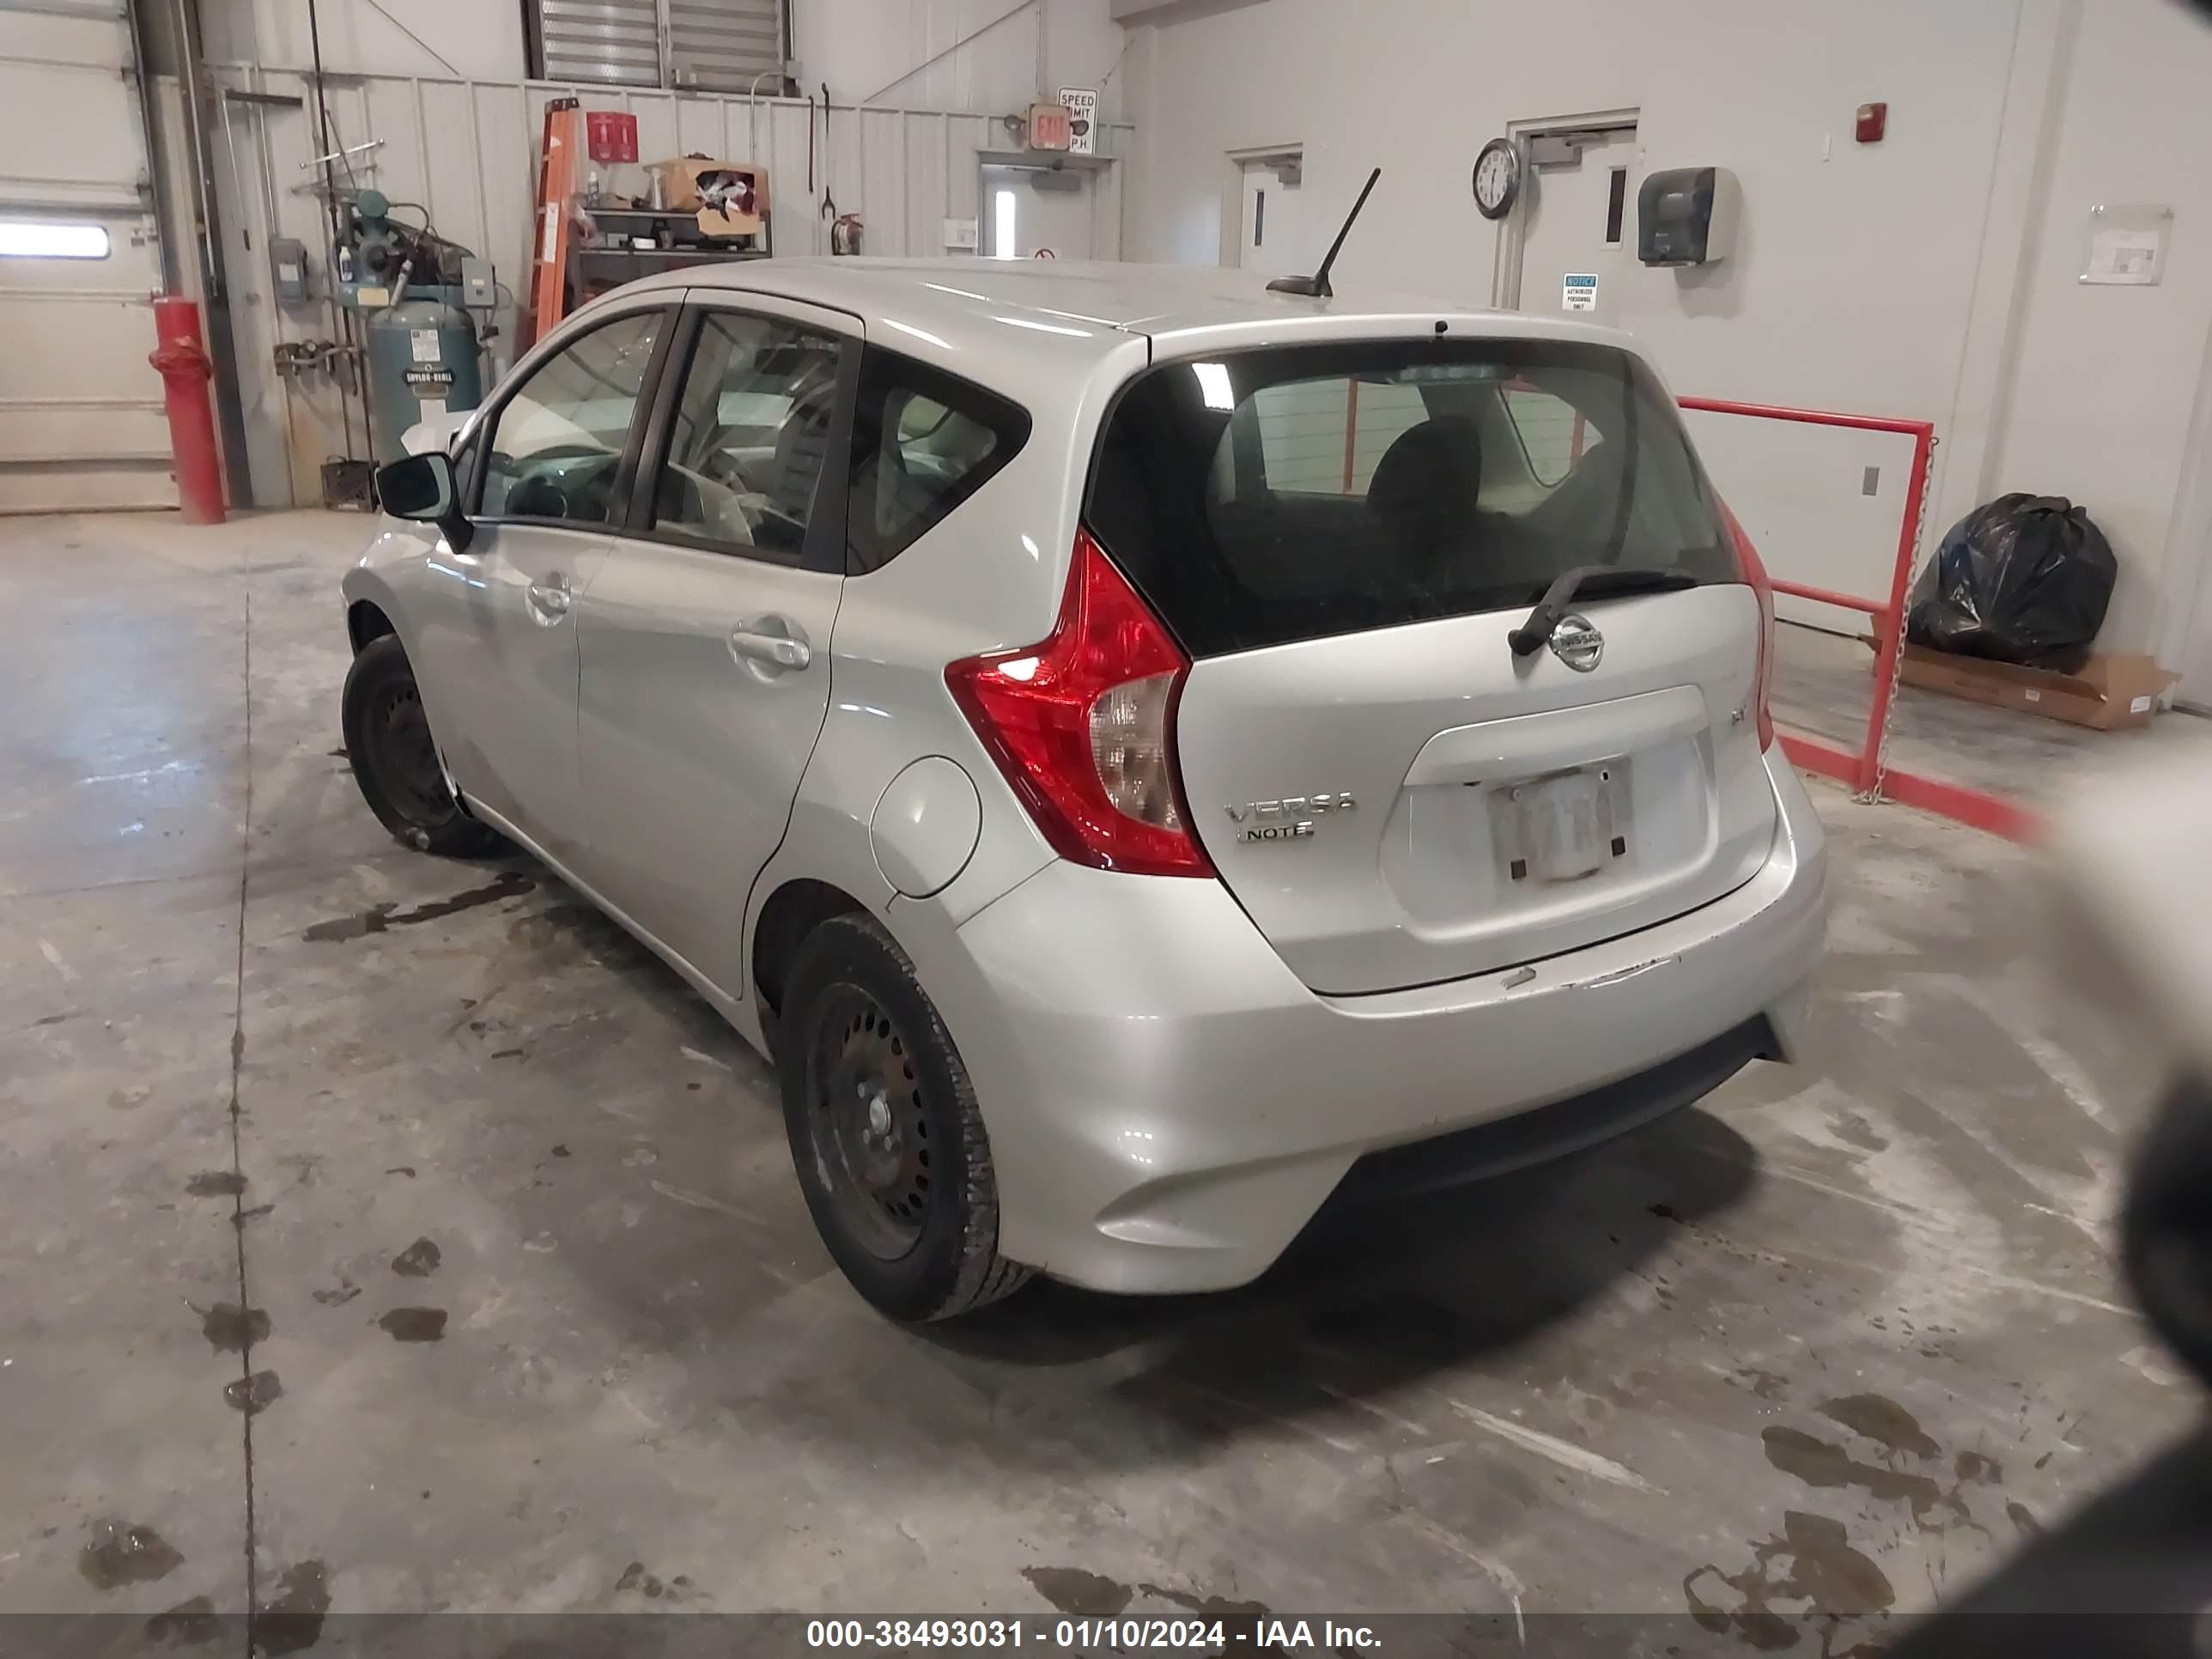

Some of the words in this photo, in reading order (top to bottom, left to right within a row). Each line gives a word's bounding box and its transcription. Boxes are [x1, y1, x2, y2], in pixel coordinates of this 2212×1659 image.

[1061, 94, 1095, 106] SPEED
[1070, 107, 1090, 118] IMIT
[1037, 116, 1066, 140] EXIT
[1567, 276, 1595, 287] NOTICE
[1560, 632, 1602, 646] NISSAN
[1223, 792, 1358, 823] VERSA
[1247, 820, 1314, 841] NOTE
